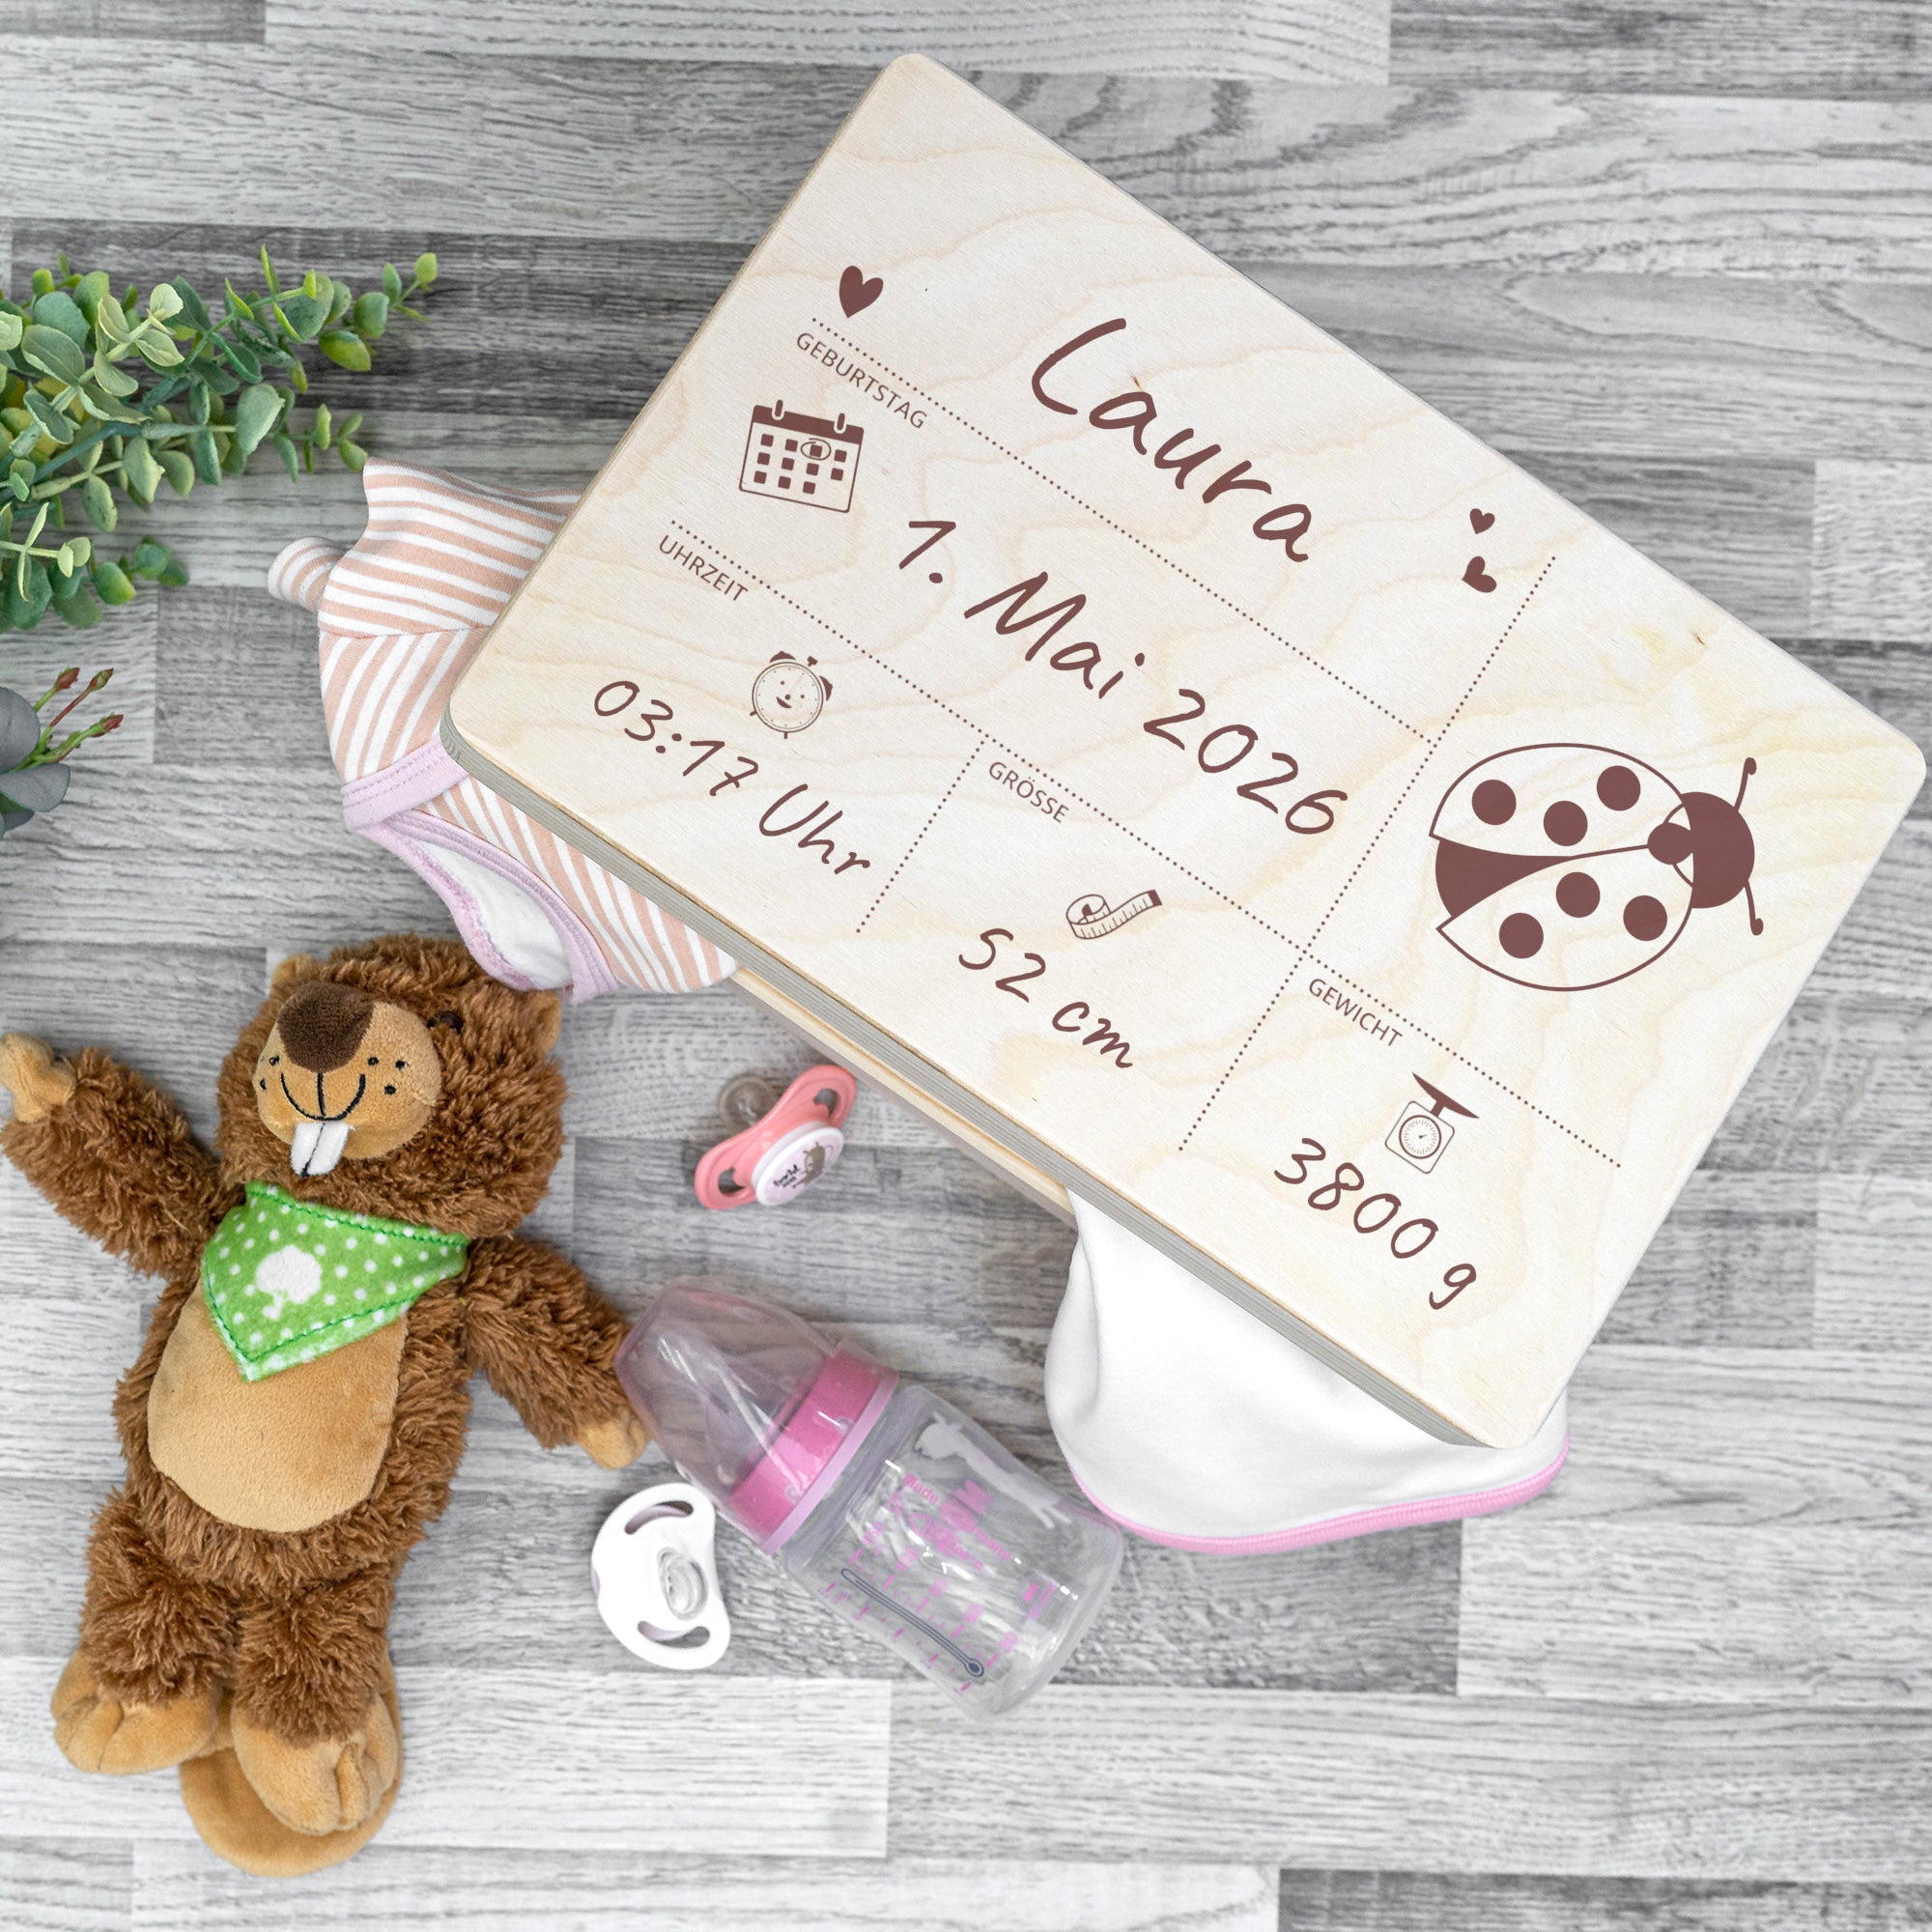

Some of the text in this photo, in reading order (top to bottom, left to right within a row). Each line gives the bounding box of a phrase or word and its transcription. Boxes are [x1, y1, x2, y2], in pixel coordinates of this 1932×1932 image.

[795, 332, 928, 429] GEBURTSTAG
[1031, 318, 1312, 563] Laura
[658, 534, 749, 602] UHRZEIT
[895, 520, 1349, 835] 1. Mai 2026
[594, 680, 870, 874] 03:17 Uhr
[988, 760, 1070, 824] GRÖSSE
[958, 927, 1133, 1068] 52 cm
[1308, 978, 1404, 1047] GEWICHT
[1273, 1137, 1477, 1311] 3800 g
[903, 1472, 939, 1505] Made
